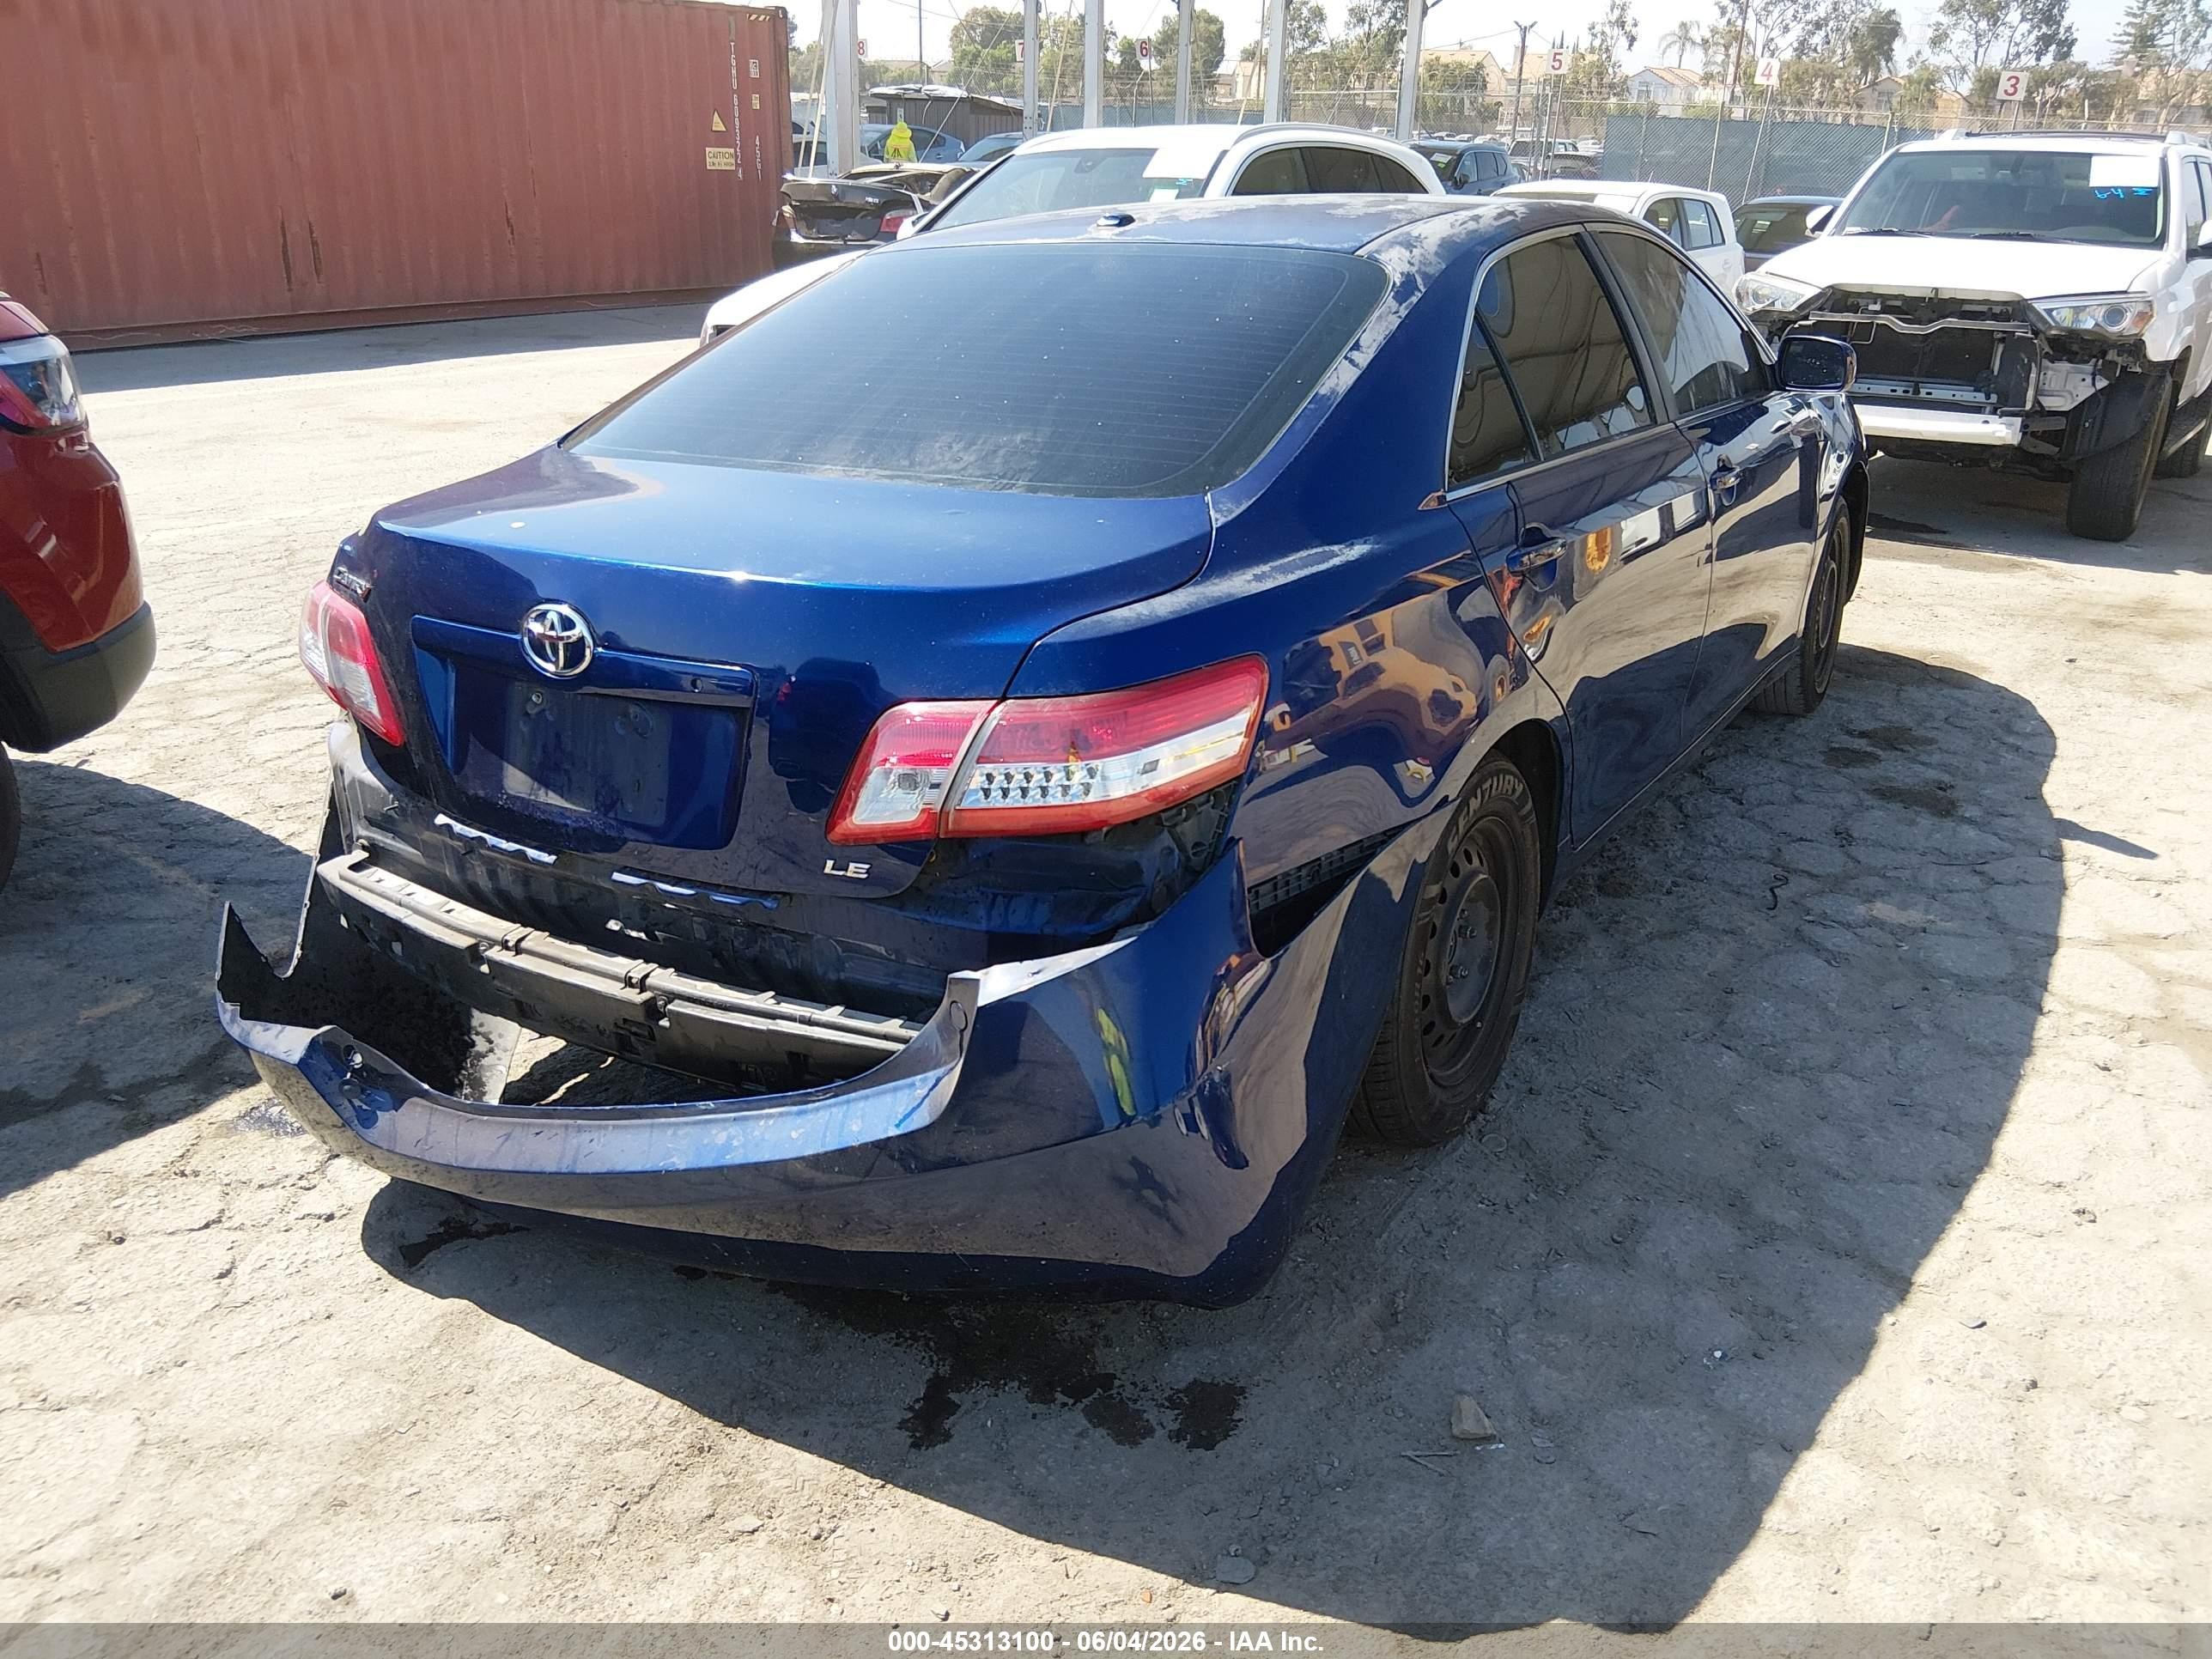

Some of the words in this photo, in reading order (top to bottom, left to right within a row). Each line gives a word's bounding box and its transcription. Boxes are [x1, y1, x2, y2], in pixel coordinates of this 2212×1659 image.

[858, 40, 865, 56] 8
[1018, 42, 1024, 58] 7
[1139, 40, 1148, 58] 6
[1551, 52, 1563, 70] 5
[1760, 61, 1772, 82] 4
[2003, 75, 2021, 97] 3
[708, 150, 734, 160] CAUTION
[823, 859, 872, 879] LE
